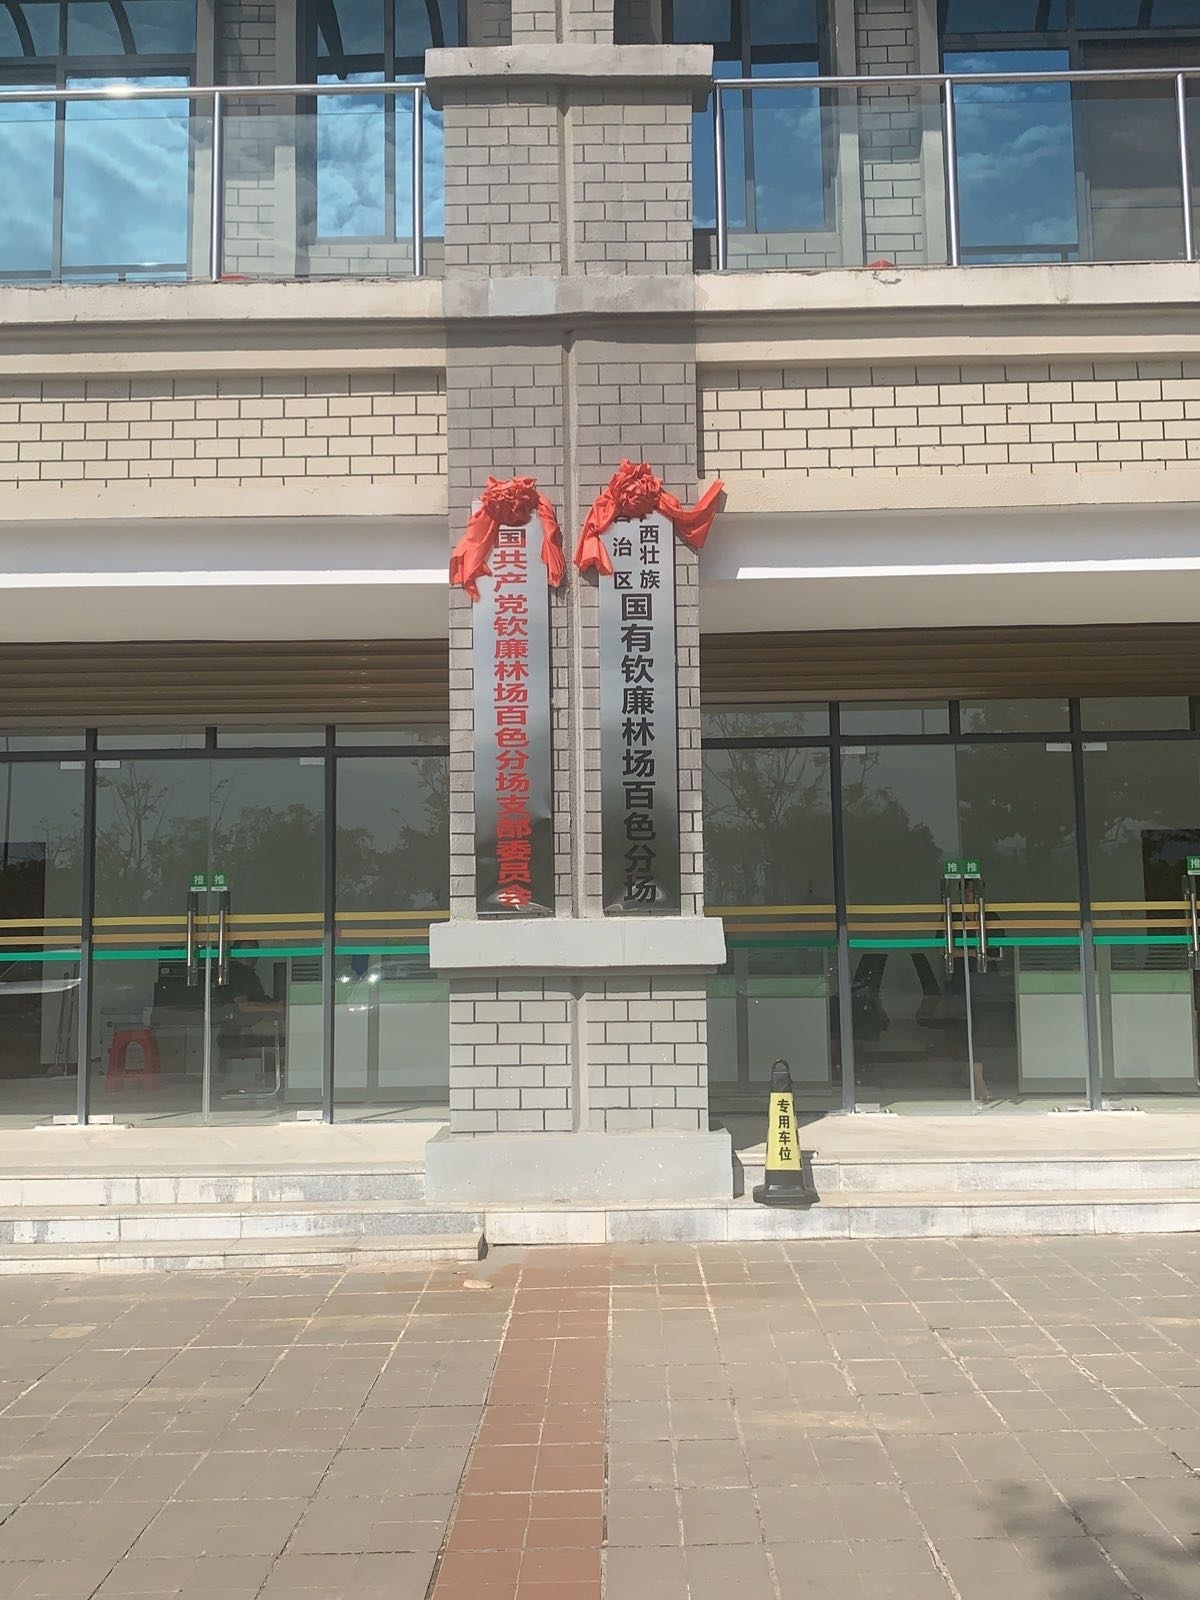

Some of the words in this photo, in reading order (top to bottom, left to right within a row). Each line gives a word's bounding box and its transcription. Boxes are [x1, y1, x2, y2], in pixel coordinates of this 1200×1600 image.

[621, 593, 656, 903] 国有钦廉林场百色分场
[947, 862, 958, 873] 推
[966, 862, 977, 873] 推
[194, 874, 205, 885] 推
[214, 874, 225, 885] 推
[777, 1099, 791, 1161] 专用车位
